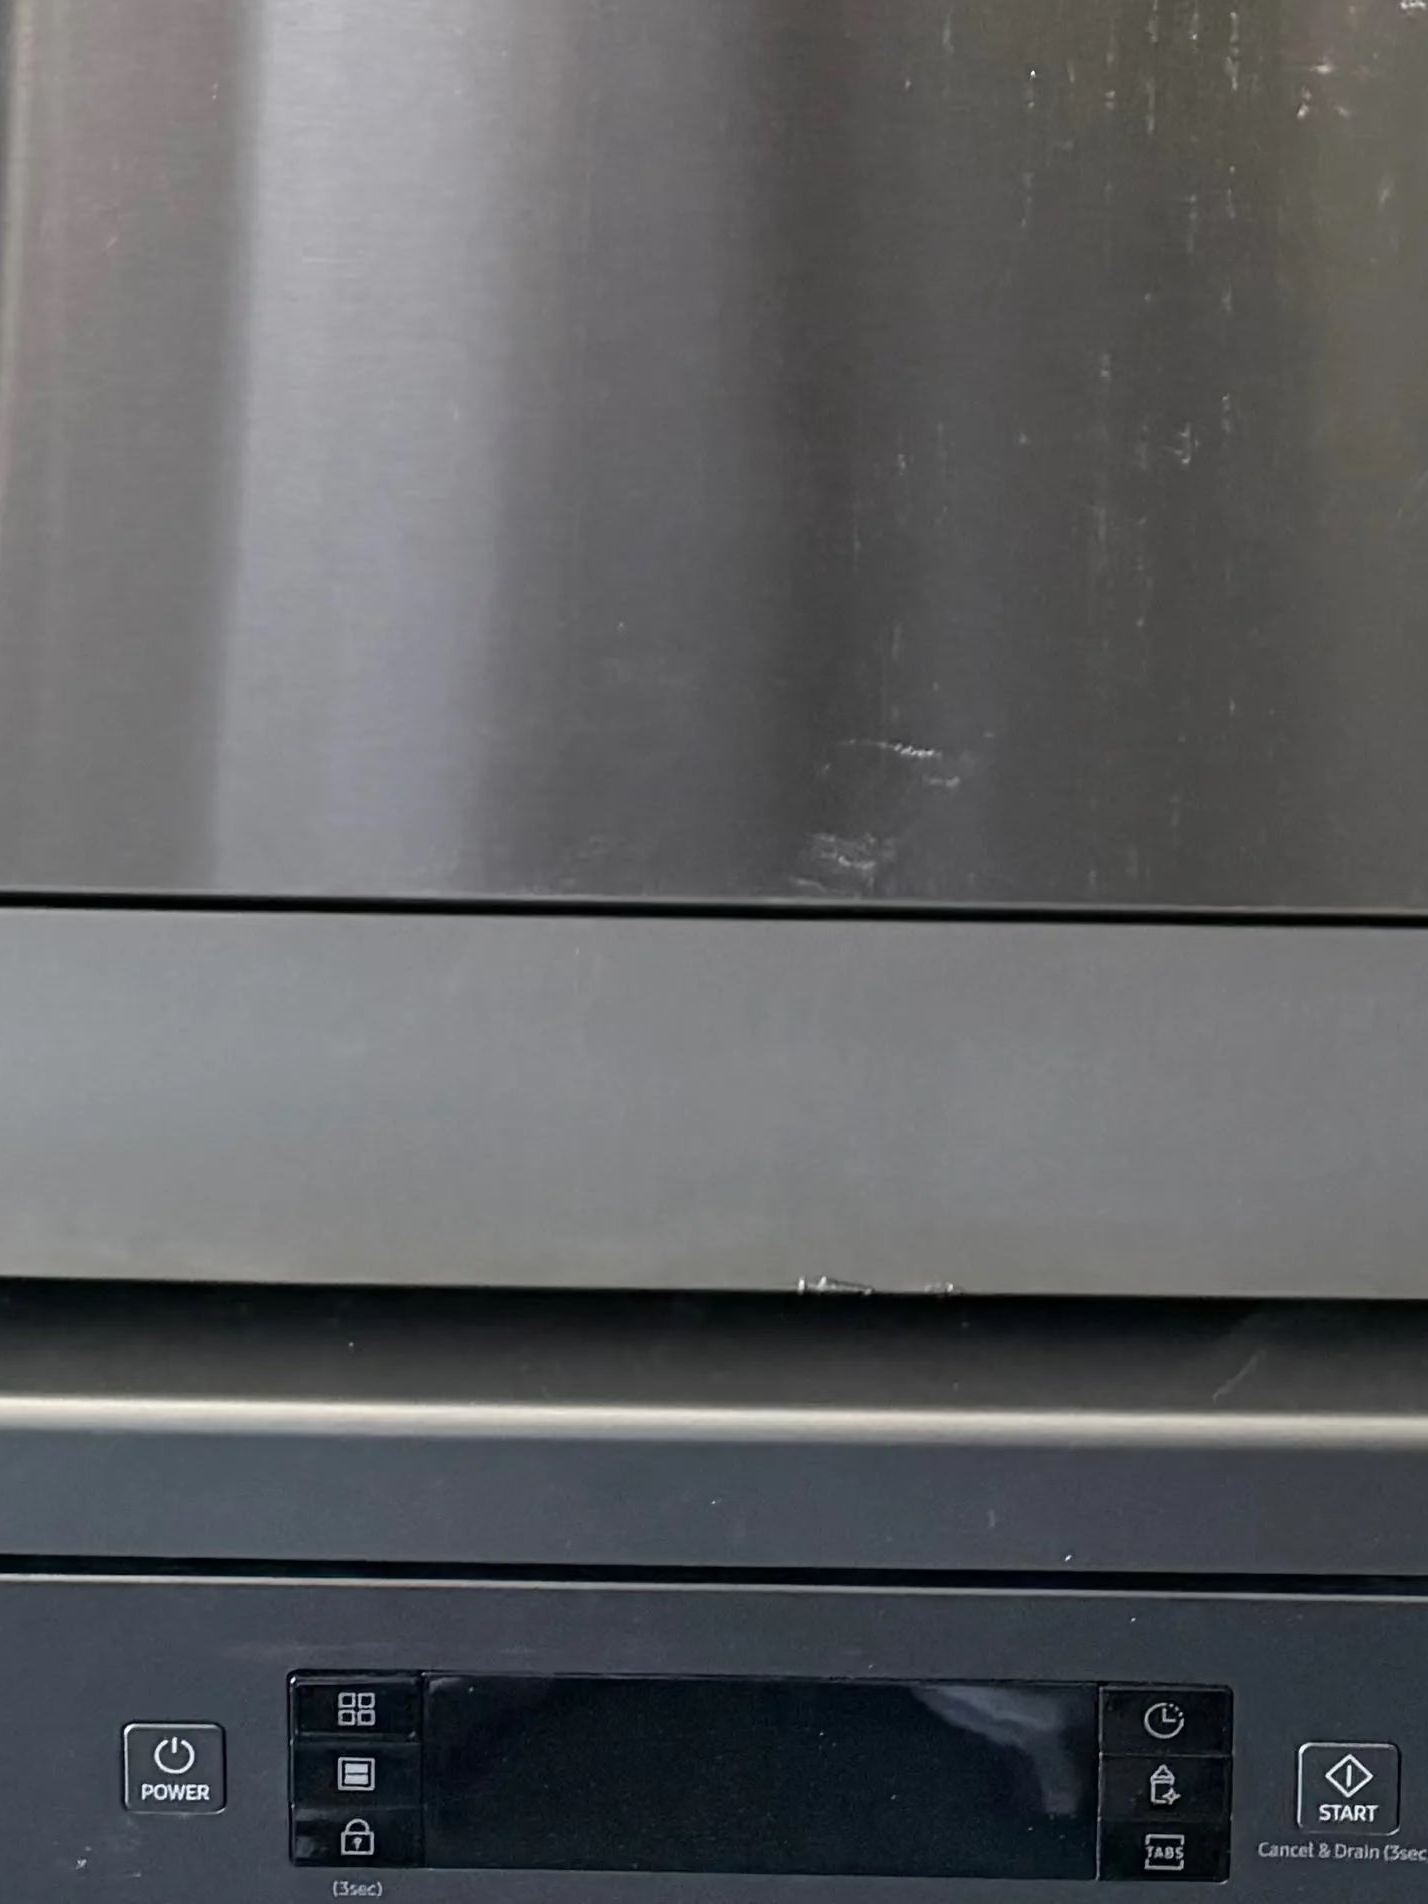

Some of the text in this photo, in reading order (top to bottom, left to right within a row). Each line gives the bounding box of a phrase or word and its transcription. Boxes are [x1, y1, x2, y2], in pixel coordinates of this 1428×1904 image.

[140, 1783, 211, 1802] POWER
[1318, 1804, 1379, 1823] START
[1144, 1845, 1185, 1861] TABS
[1257, 1841, 1315, 1860] Cancel
[1318, 1843, 1331, 1860] &
[1334, 1842, 1381, 1861] Drain
[331, 1880, 384, 1899] (3sec)
